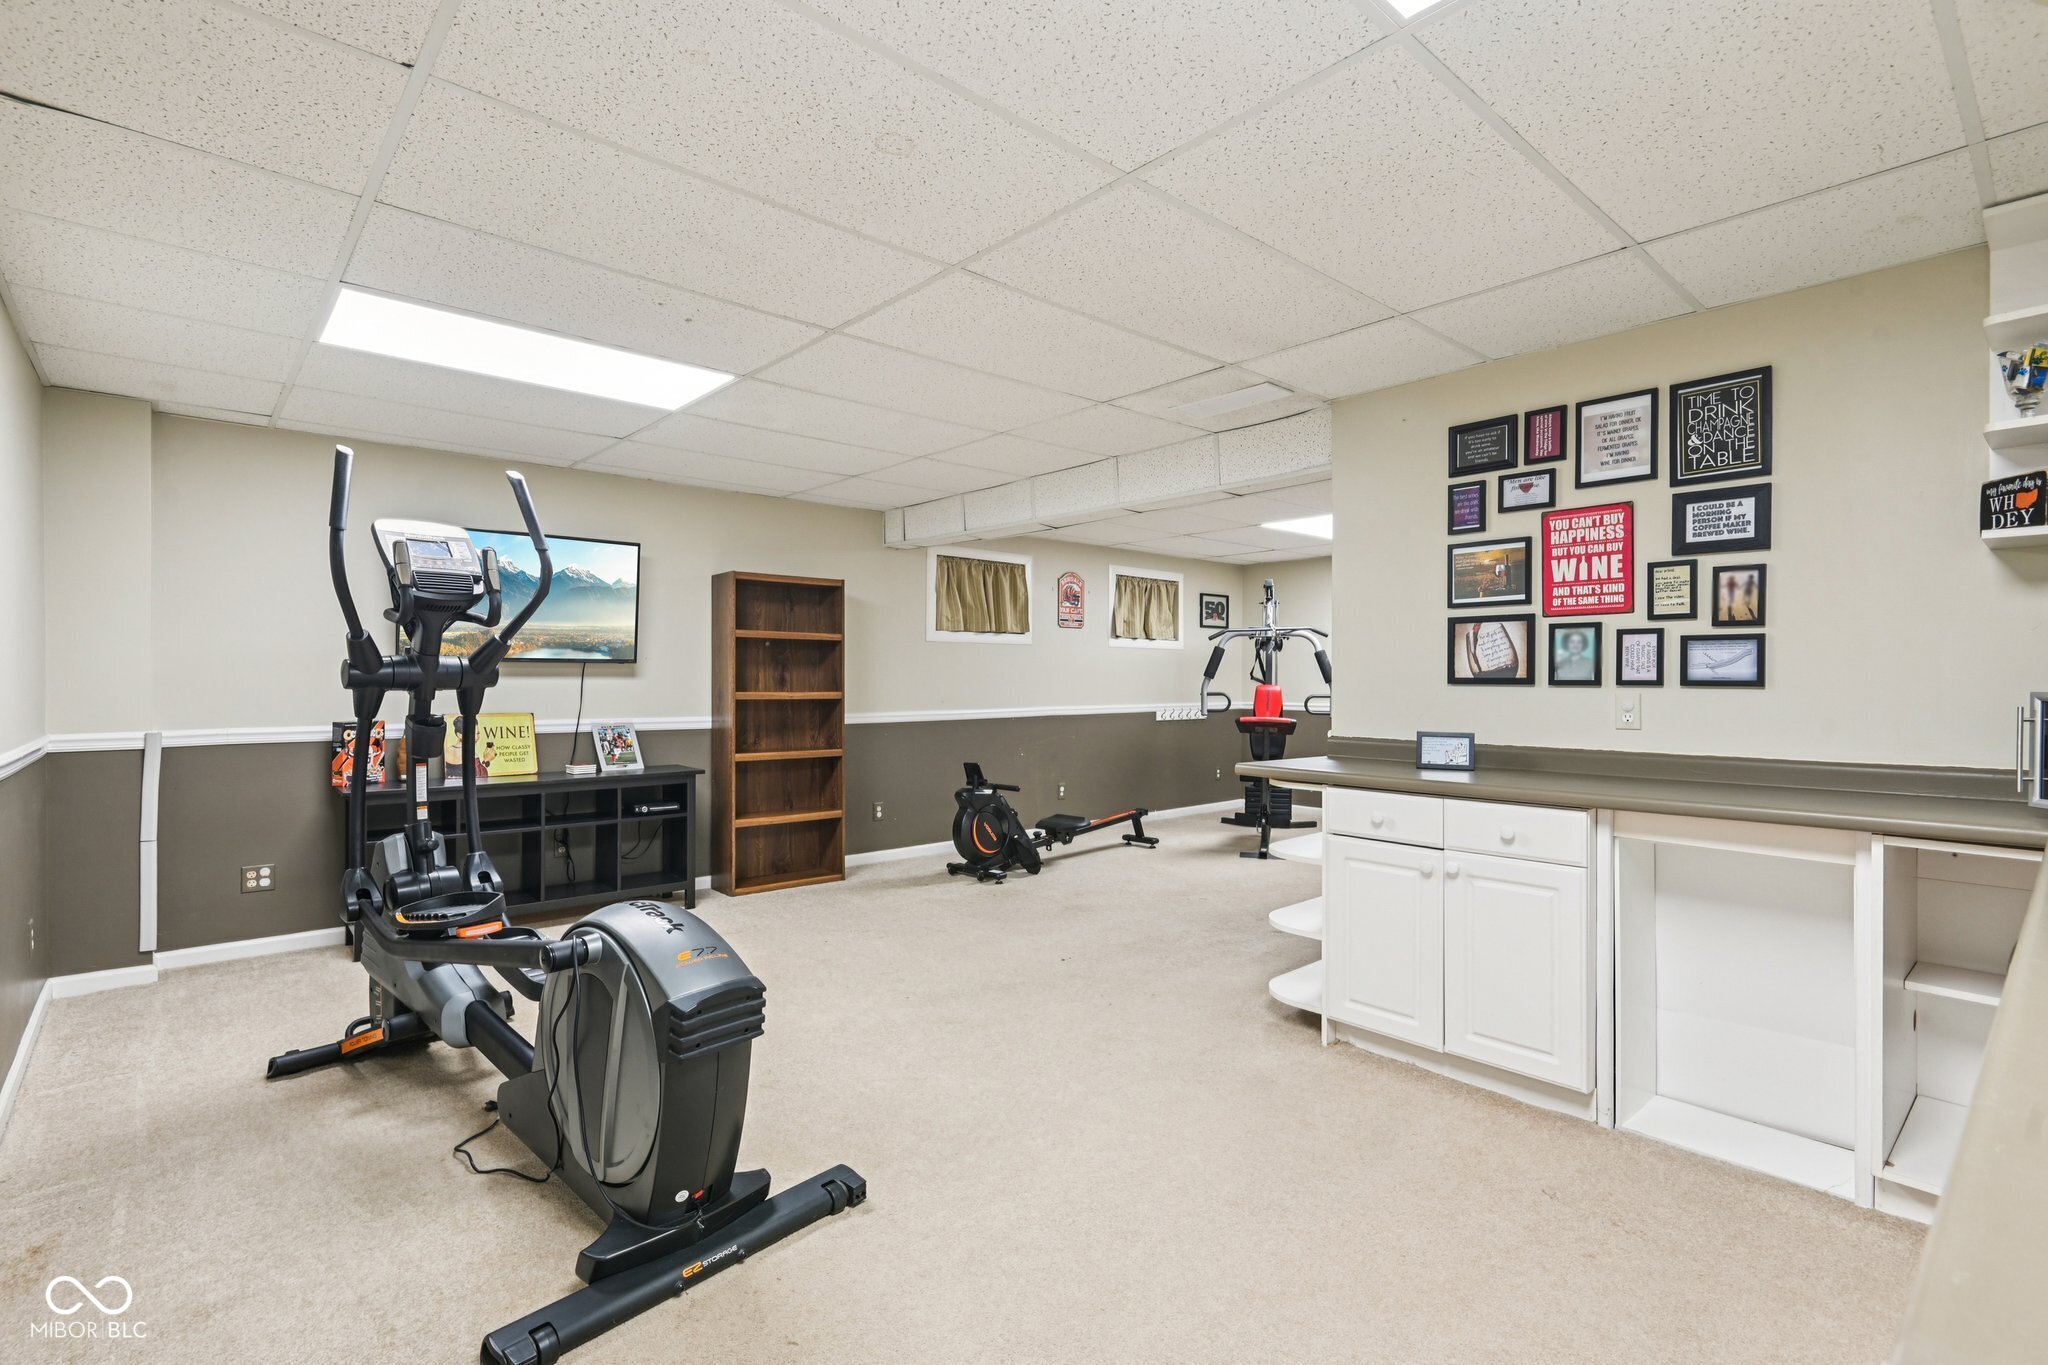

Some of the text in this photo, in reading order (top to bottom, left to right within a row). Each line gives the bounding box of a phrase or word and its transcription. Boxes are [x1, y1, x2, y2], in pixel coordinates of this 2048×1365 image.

[1688, 386, 1754, 408] TIME TO
[1688, 398, 1754, 423] DRINK
[1687, 412, 1755, 435] CHAMPAGNE
[1598, 444, 1620, 452] FERMENTED
[1688, 436, 1755, 456] ON THE
[1688, 446, 1755, 470] TABLE
[2022, 476, 2035, 489] day
[1692, 509, 1732, 518] MORNING
[1696, 503, 1724, 511] COULD
[1549, 512, 1625, 531] YOU CAN'T BUY
[1692, 516, 1724, 524] PERSON
[1692, 520, 1752, 531] COFFEE MAKER
[1992, 508, 2035, 530] DEY
[1550, 524, 1624, 544] HAPPINESS
[1692, 530, 1724, 538] BREWED
[1552, 542, 1624, 557] BUT YOU CAN BUY
[1550, 554, 1624, 582] WINE
[1552, 583, 1625, 597] AND THAT'S KIND
[1552, 594, 1624, 606] OF THE SAME THING
[484, 726, 530, 739] WINE!
[627, 901, 685, 934] cTrack
[682, 1244, 738, 1278] EZ STORAGE
